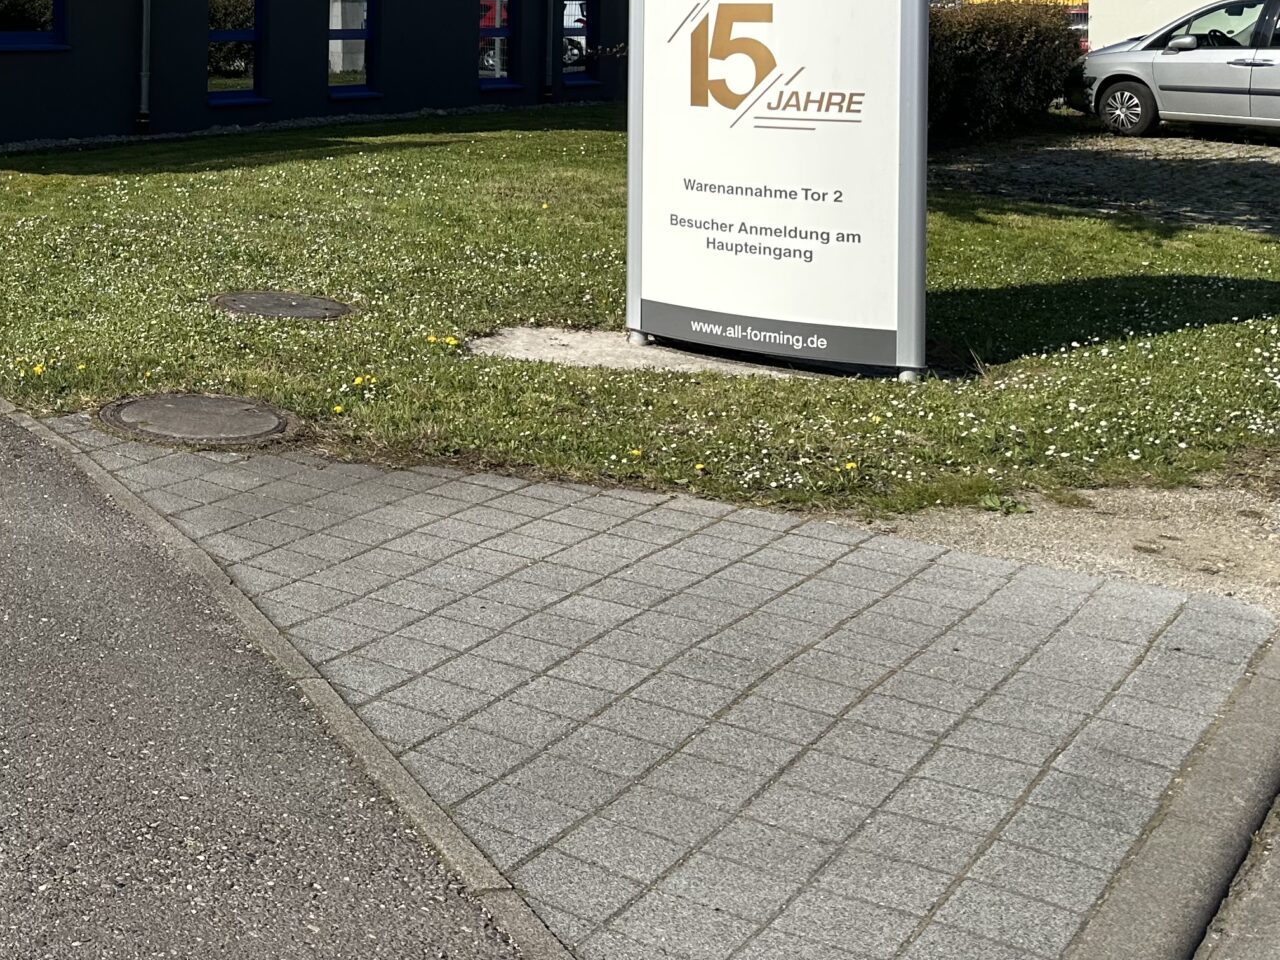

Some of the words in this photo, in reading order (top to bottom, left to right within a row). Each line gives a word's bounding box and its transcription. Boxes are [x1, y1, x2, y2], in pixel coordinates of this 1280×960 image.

[690, 2, 778, 111] 15
[766, 90, 866, 114] JAHRE
[683, 177, 798, 201] Warenannahme
[801, 187, 829, 203] Tor
[832, 190, 844, 203] 2
[669, 213, 734, 233] Besucher
[737, 221, 831, 245] Anmeldung
[835, 231, 862, 244] am
[705, 236, 814, 263] Haupteingang
[690, 319, 828, 350] www.all-forming.de
